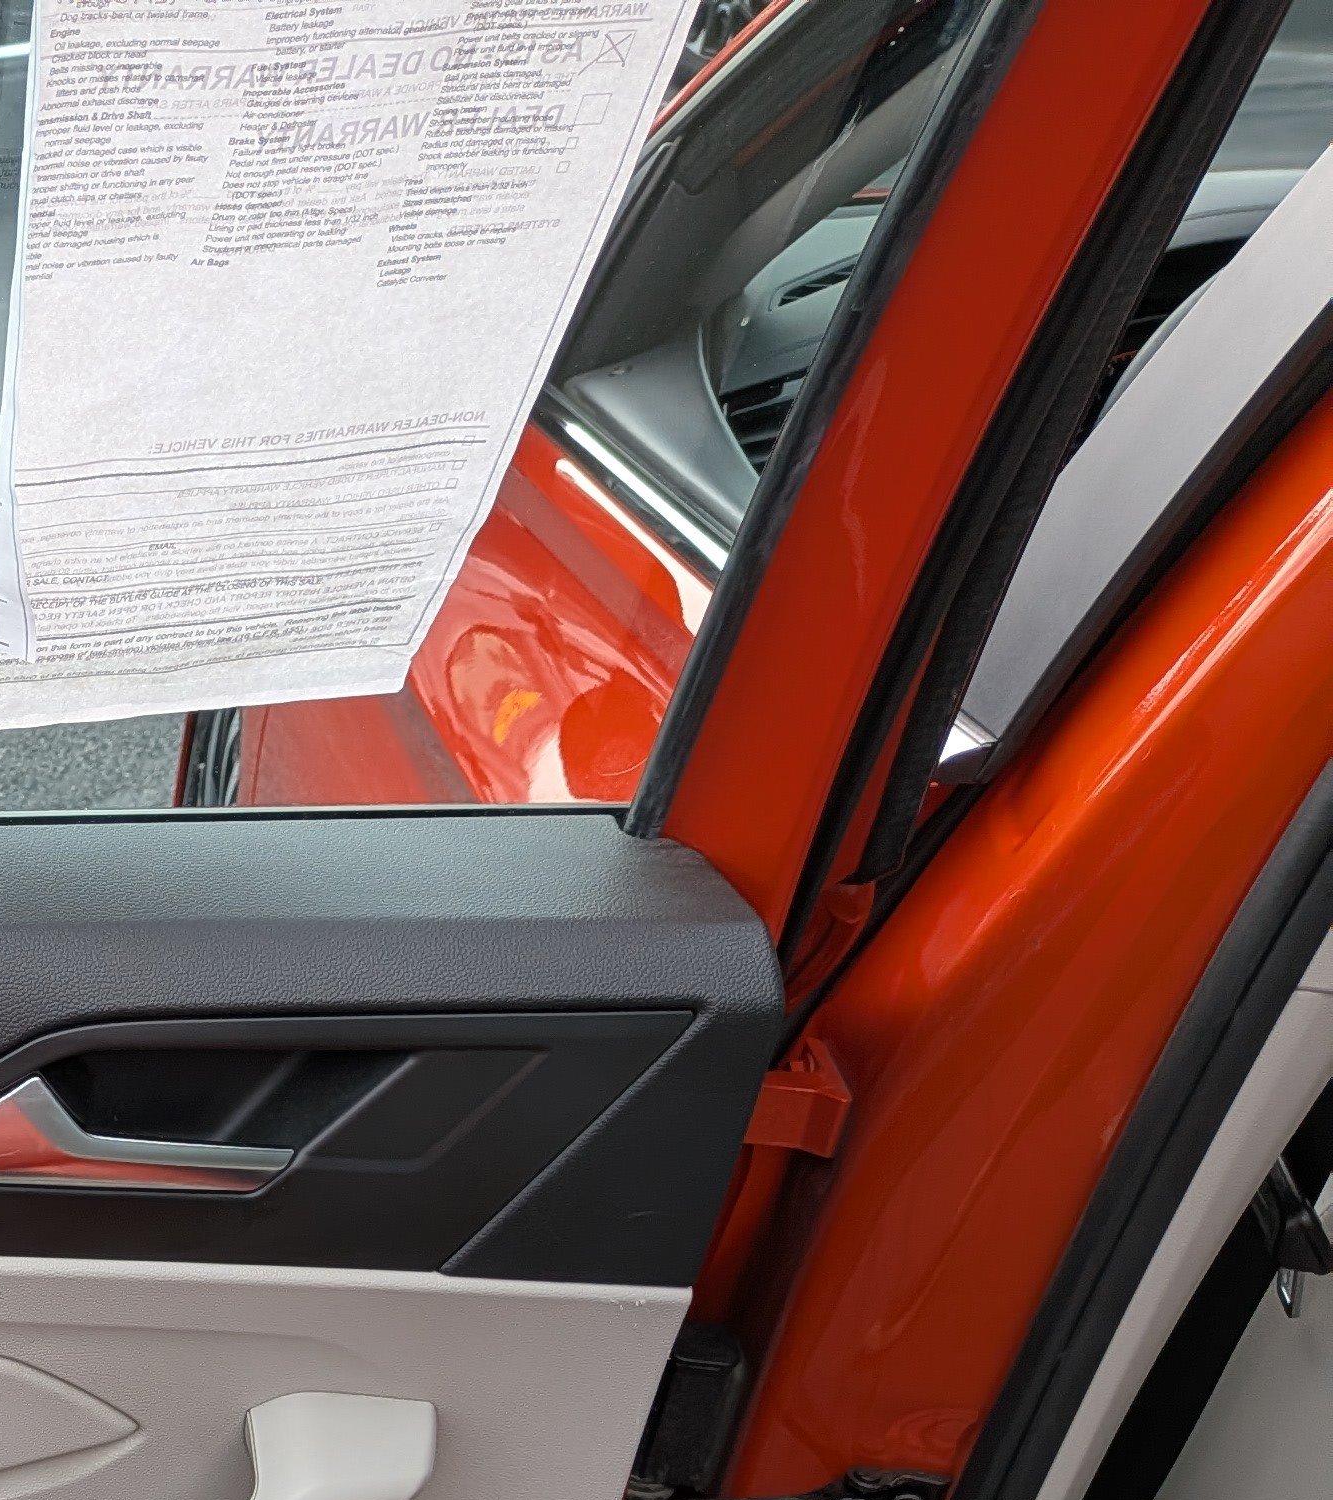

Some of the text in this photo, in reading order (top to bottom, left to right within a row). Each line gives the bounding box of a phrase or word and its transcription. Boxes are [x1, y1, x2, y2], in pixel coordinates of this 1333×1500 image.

[265, 6, 342, 20] Electrical System
[50, 28, 80, 38] Engine
[405, 178, 422, 186] Tires
[191, 258, 229, 267] Air Bags
